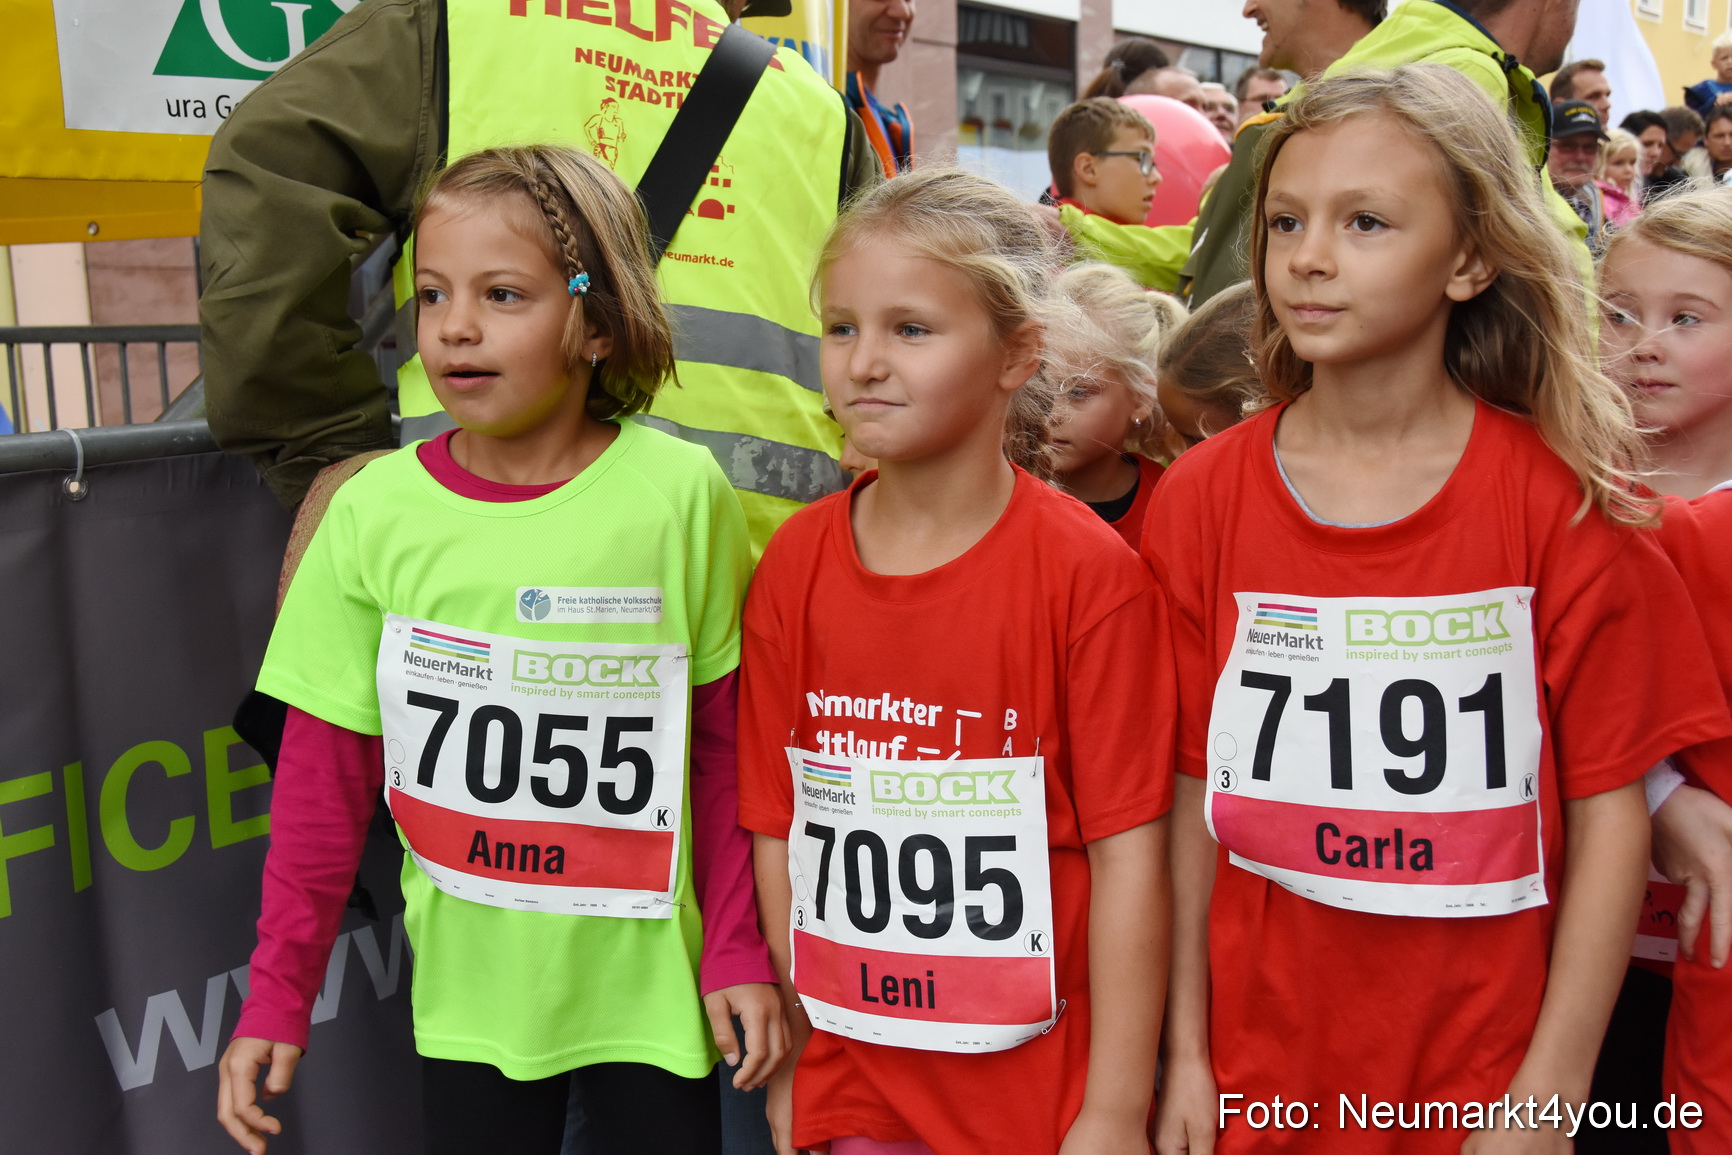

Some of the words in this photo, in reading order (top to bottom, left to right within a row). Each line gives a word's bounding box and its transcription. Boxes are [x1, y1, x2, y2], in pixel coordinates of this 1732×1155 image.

[215, 94, 242, 119] G
[557, 596, 577, 605] Freie
[579, 596, 622, 605] katholische
[623, 596, 662, 605] Volksschule
[567, 606, 585, 614] Haus
[1345, 601, 1513, 646] BOCK
[1247, 628, 1323, 650] NeuerMarkt
[1268, 650, 1284, 658] leben
[1345, 648, 1398, 661] inspired
[1402, 648, 1419, 662] by
[1423, 648, 1462, 660] smart
[1465, 642, 1513, 659] concepts
[403, 650, 493, 681] NeuerMarkt
[512, 649, 660, 687] BOCK
[406, 669, 434, 681] einkaufen
[437, 675, 454, 685] leben
[458, 680, 488, 691] genießen
[510, 682, 556, 698] inspired
[559, 686, 573, 701] by
[576, 688, 610, 699] smart
[613, 689, 661, 702] concepts
[1240, 669, 1508, 795] 7191
[406, 690, 654, 815] 7055
[393, 770, 401, 786] 3
[870, 770, 1022, 806] BOCK
[1221, 771, 1230, 789] 3
[1524, 778, 1533, 797] K
[801, 781, 856, 805] NeuerMarkt
[656, 810, 668, 826] K
[872, 806, 911, 819] inspired
[914, 807, 928, 819] by
[931, 807, 965, 818] smart
[969, 806, 1022, 819] concepts
[466, 830, 565, 875] Anna
[1315, 822, 1434, 872] Carla
[804, 821, 1024, 941] 7095
[797, 909, 804, 926] 3
[1030, 933, 1043, 952] K
[860, 962, 936, 1010] Leni
